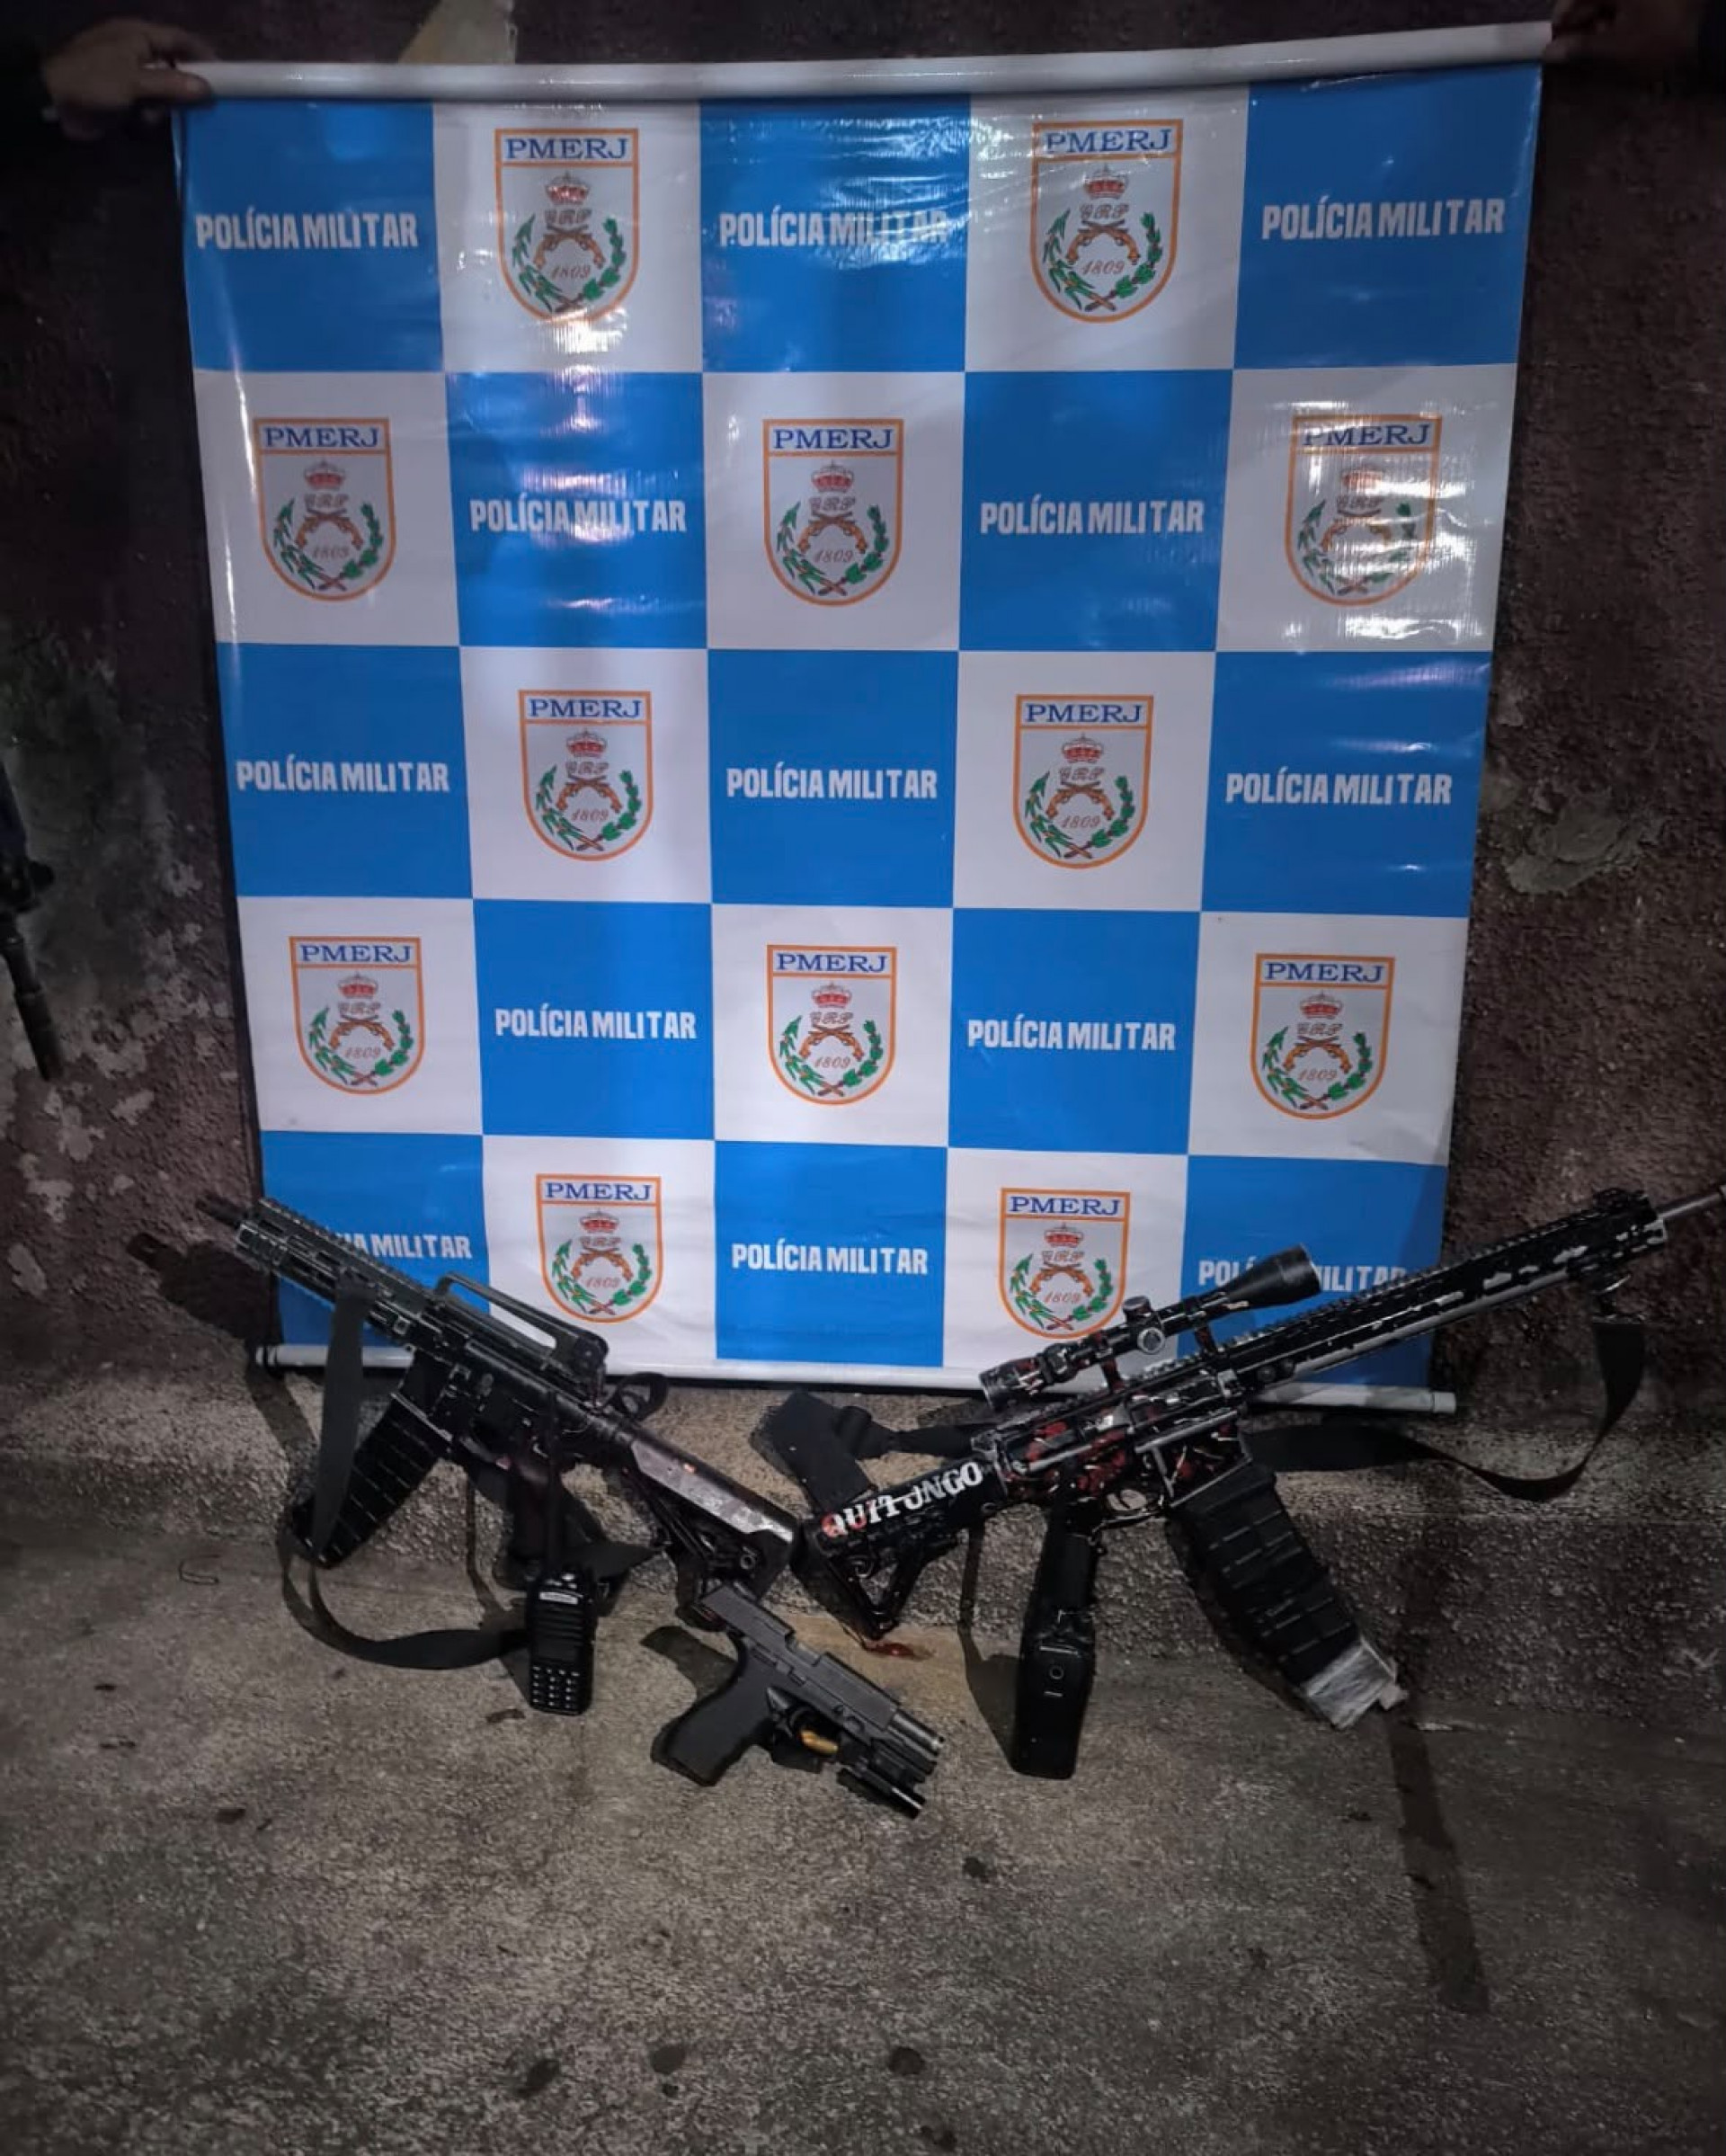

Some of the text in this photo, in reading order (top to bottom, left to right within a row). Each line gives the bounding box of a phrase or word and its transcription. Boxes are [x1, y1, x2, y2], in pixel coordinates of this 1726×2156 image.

[506, 138, 628, 160] PMERJ
[1045, 129, 1172, 153] PMERJ
[720, 205, 946, 246] POLÍCIA MILITAR
[1262, 195, 1505, 240] POLÍCIA MILITAR
[196, 209, 418, 249] POLÍCIA MILITAR
[1082, 260, 1125, 275] 1809
[264, 427, 379, 448] PMERJ
[773, 429, 893, 450] PMERJ
[470, 493, 686, 533] POLÍCIA MILITAR
[981, 494, 1204, 535] POLÍCIA MILITAR
[815, 548, 854, 565] 1809
[529, 699, 641, 719] PMERJ
[1026, 704, 1142, 724] PMERJ
[236, 754, 449, 793] POLÍCIA MILITAR
[727, 762, 937, 799] POLÍCIA MILITAR
[1226, 767, 1452, 806] POLÍCIA MILITAR
[572, 808, 609, 823] 1809
[1062, 815, 1099, 830] 1809
[300, 944, 411, 964] PMERJ
[776, 953, 886, 974] PMERJ
[1264, 962, 1383, 984] PMERJ
[496, 1003, 696, 1039] POLÍCIA MILITAR
[968, 1014, 1176, 1051] POLÍCIA MILITAR
[814, 1056, 851, 1070] 1809
[546, 1182, 652, 1201] PMERJ
[1010, 1196, 1120, 1217] PMERJ
[370, 1233, 472, 1259] MILITAR
[732, 1239, 928, 1277] POLÍCIA MILITAR
